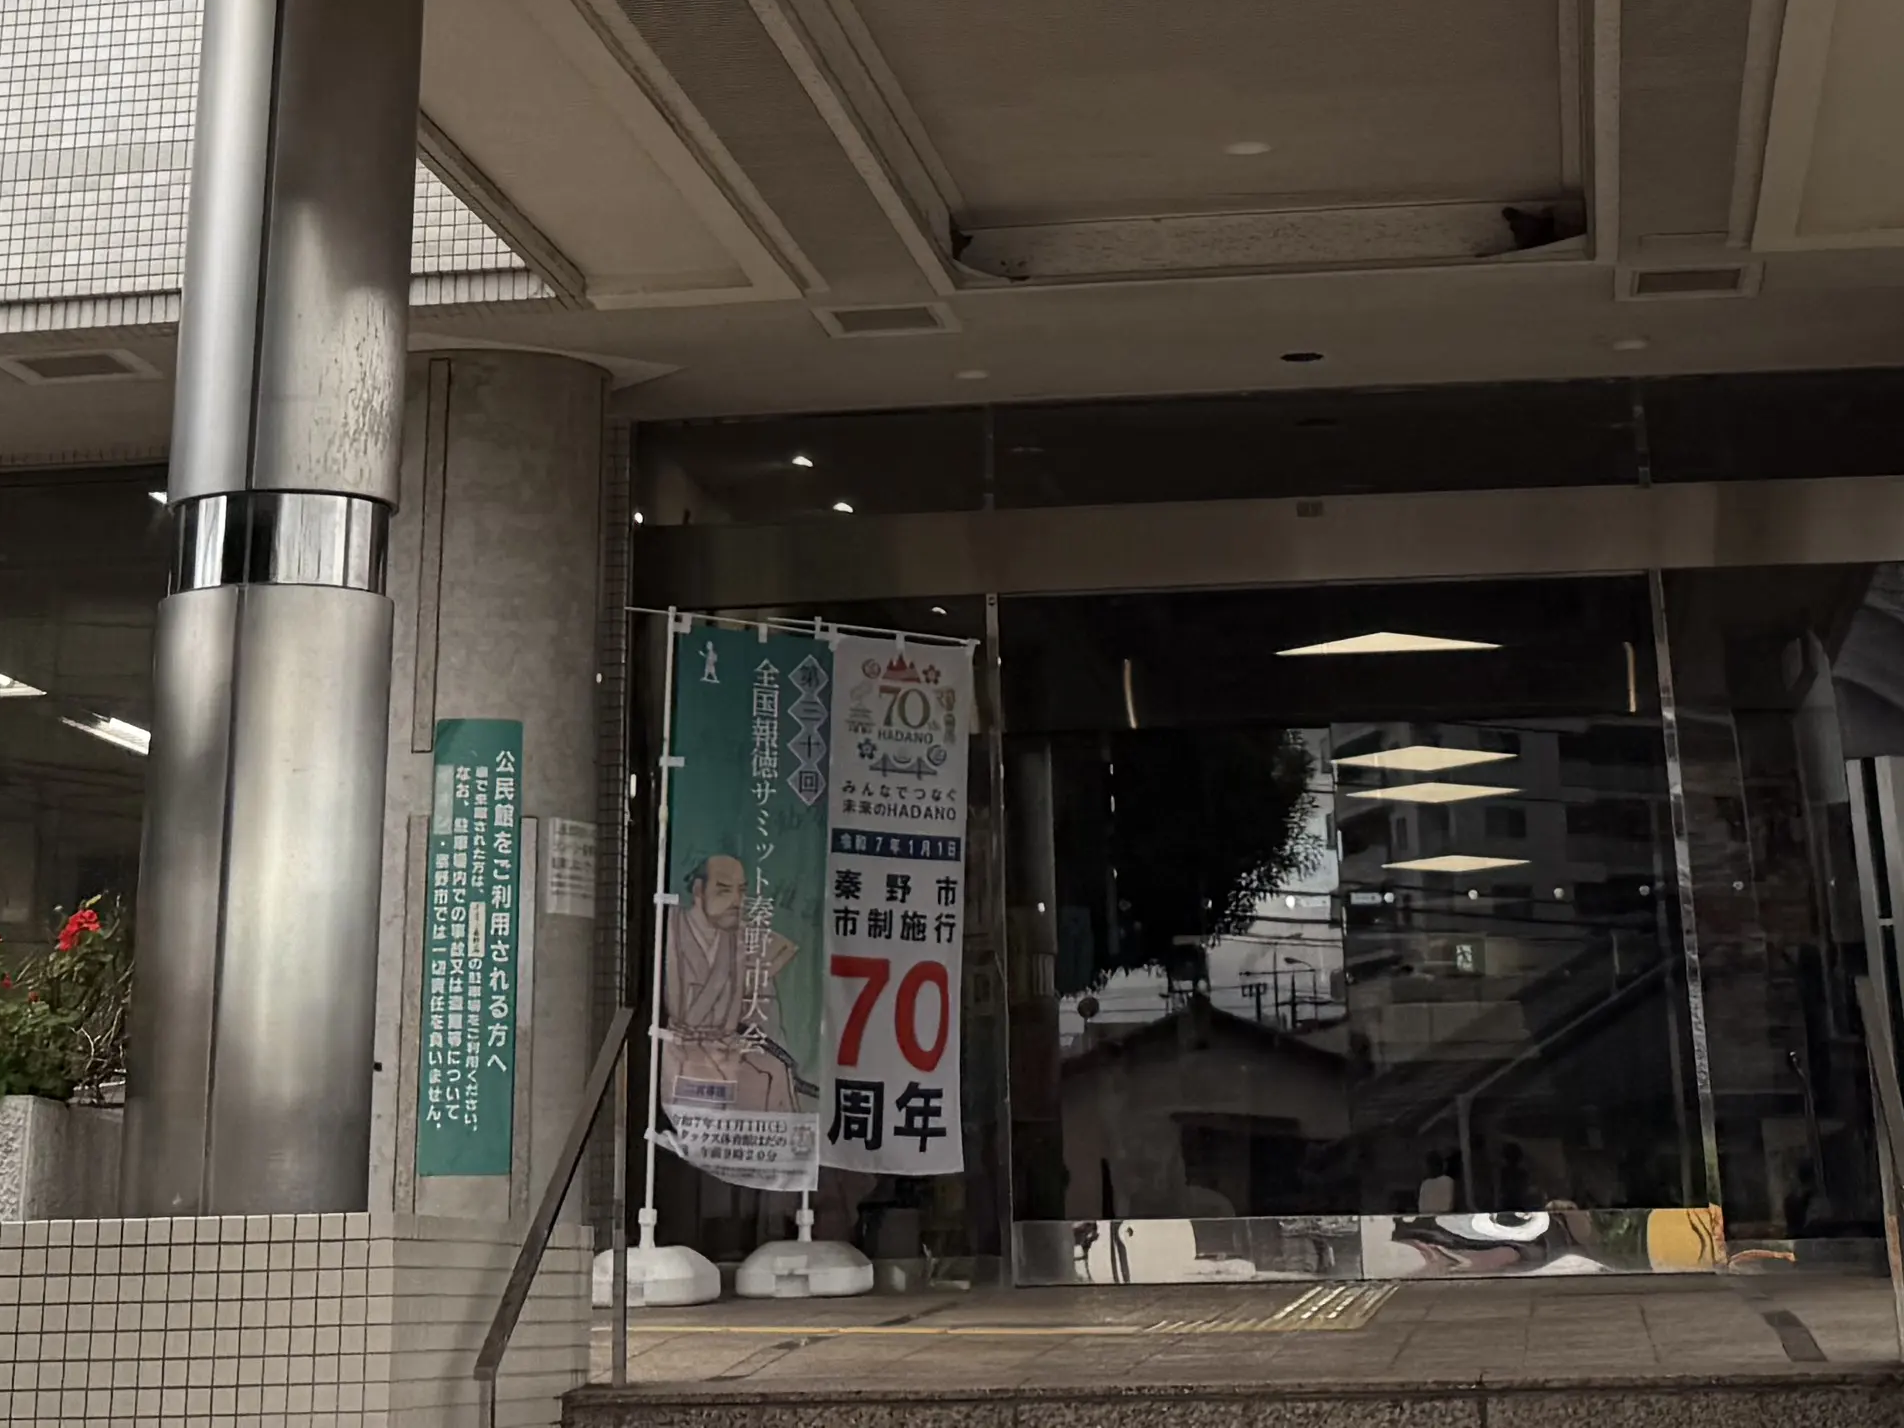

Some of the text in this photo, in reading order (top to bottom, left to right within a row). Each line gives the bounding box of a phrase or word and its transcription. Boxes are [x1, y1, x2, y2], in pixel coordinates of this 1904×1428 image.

[878, 729, 934, 745] HADANO
[842, 780, 958, 803] みんなでつなぐ
[842, 799, 957, 822] 未来のHADANO
[739, 658, 781, 1055] 全国報徳サミット秦野市大会
[833, 868, 958, 907] 秦野市
[487, 750, 516, 1073] 公民館をご利用される方へ
[833, 907, 957, 944] 市制施行
[830, 954, 950, 1073] 70
[827, 1078, 947, 1153] 周年
